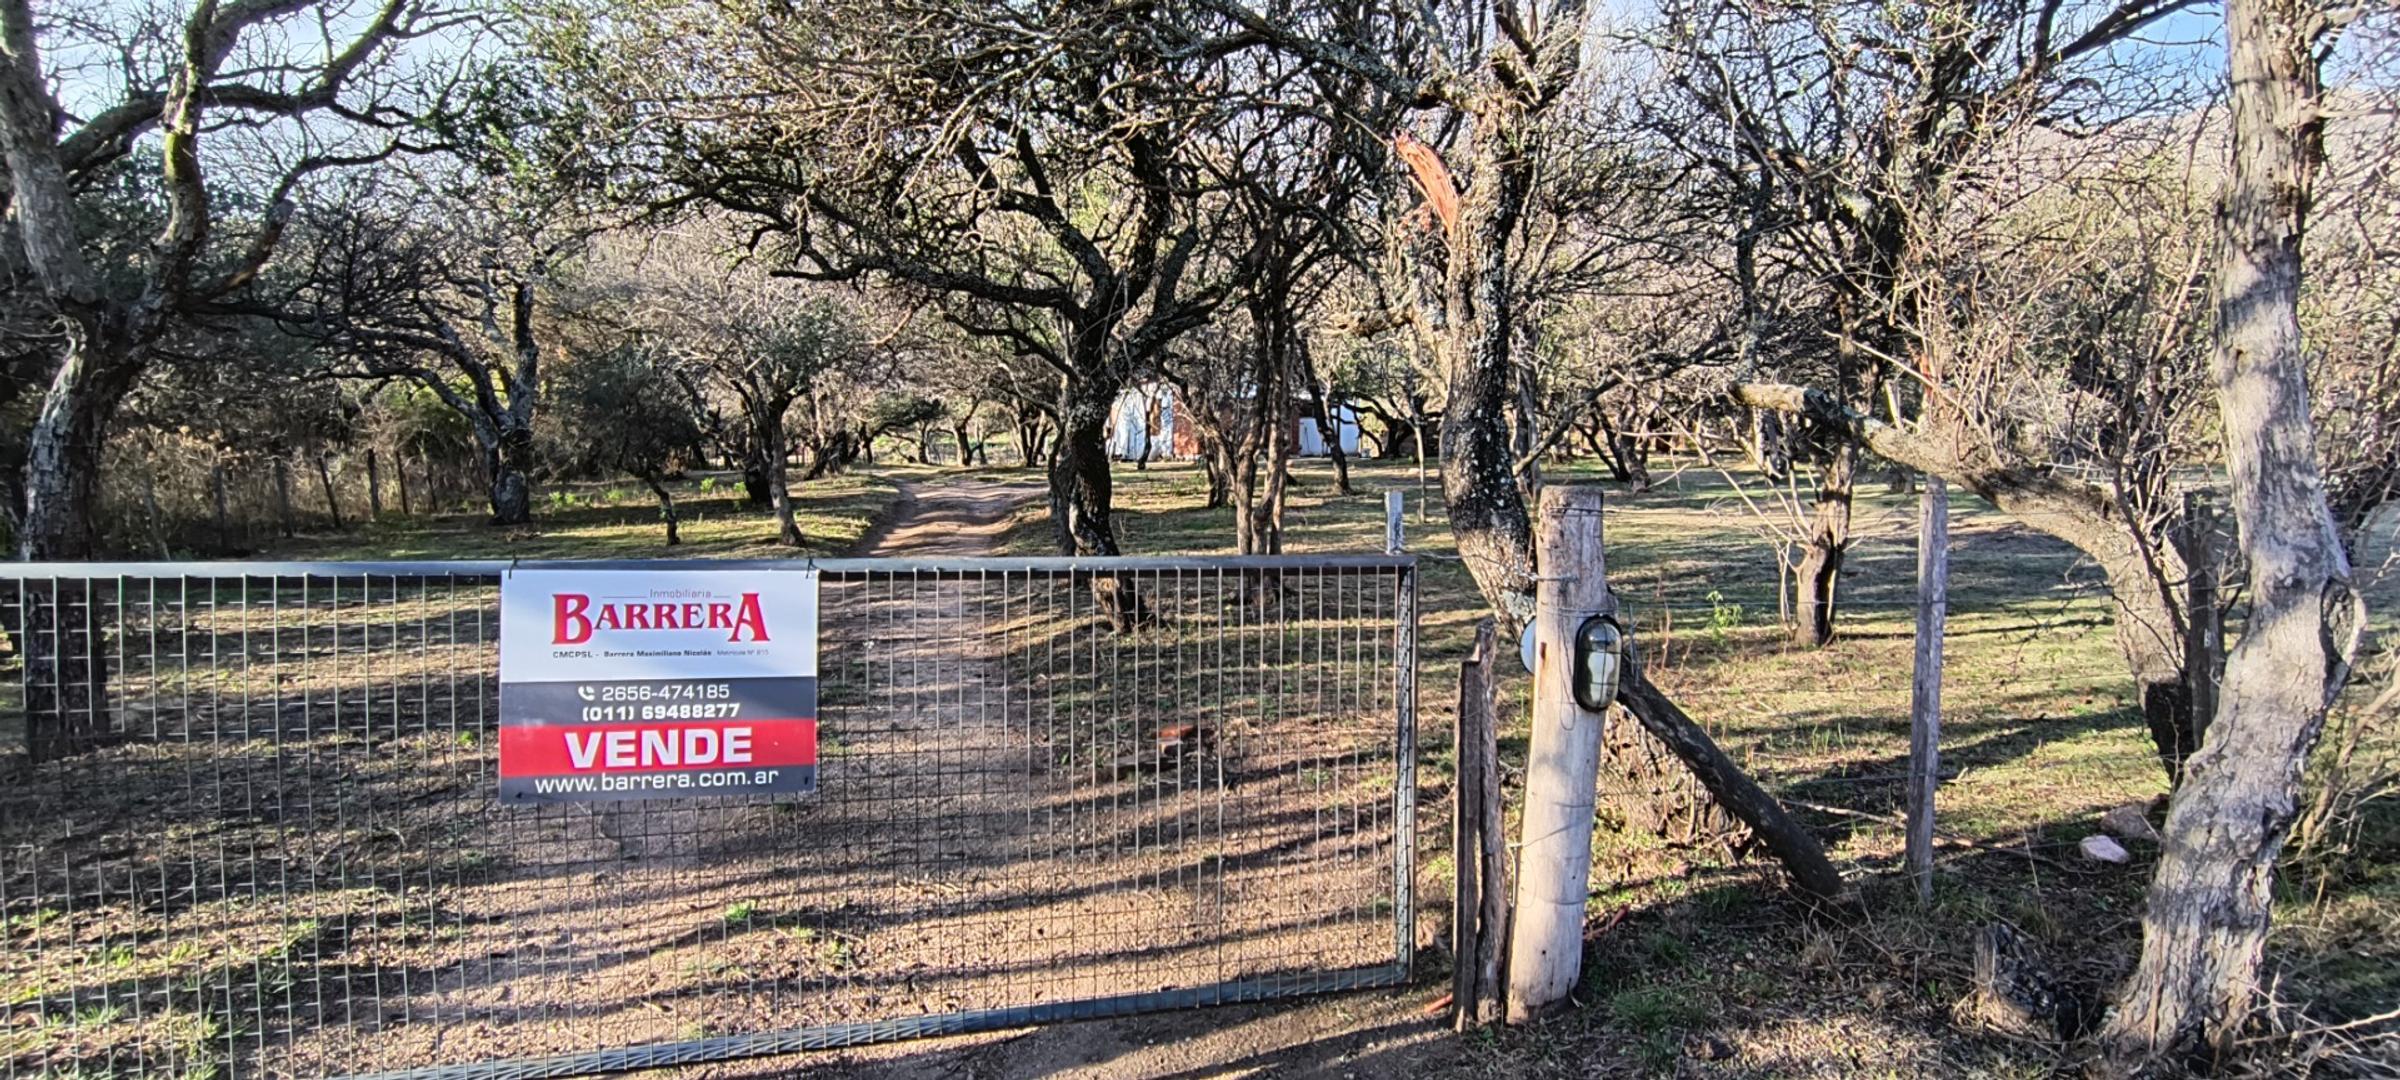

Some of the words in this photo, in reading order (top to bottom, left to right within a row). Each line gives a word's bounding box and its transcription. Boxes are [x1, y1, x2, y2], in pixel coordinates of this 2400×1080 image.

[649, 588, 712, 599] Inmobiliaria
[551, 592, 770, 645] BARRERA
[552, 651, 593, 659] CMCPSL
[604, 650, 635, 658] Barrera
[636, 649, 682, 658] Maximiliano
[602, 684, 730, 702] 2656-474185
[582, 705, 635, 722] (011)
[641, 702, 741, 720] 69488277
[563, 727, 753, 770] VENDE
[535, 768, 779, 794] www.barrera.com.ar
